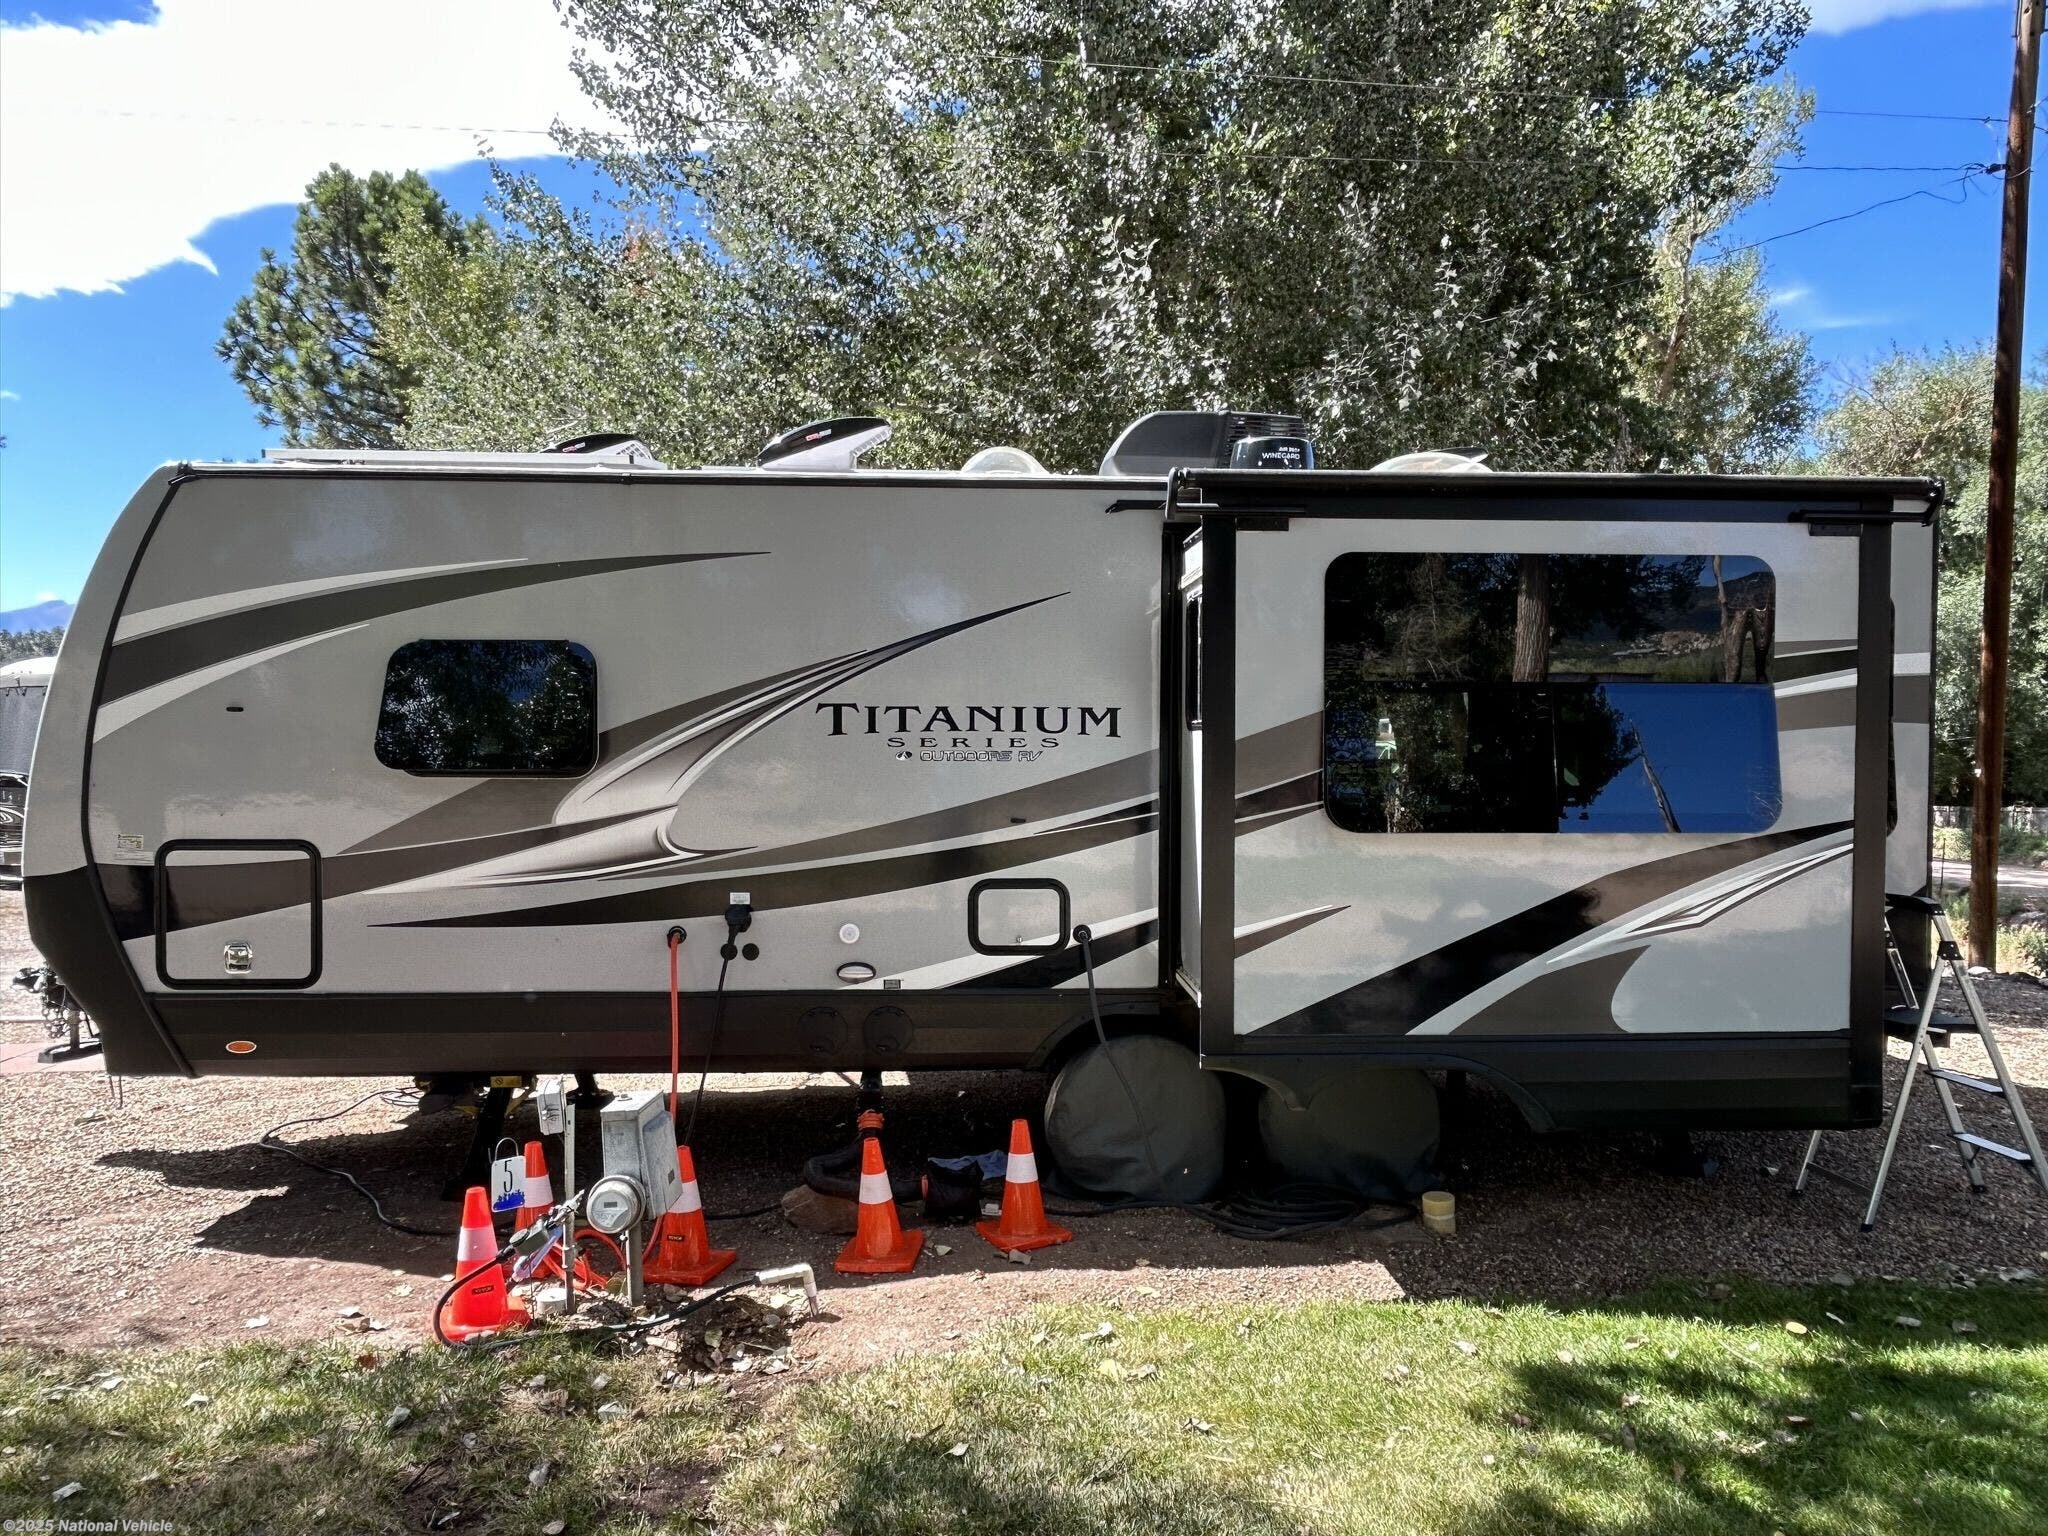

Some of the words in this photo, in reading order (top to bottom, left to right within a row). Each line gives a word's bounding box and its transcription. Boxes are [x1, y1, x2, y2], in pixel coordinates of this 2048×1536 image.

[1261, 452, 1300, 460] WINEGARD
[815, 702, 1122, 738] TITANIUM
[887, 737, 1059, 748] SERIES
[919, 750, 1014, 762] OUTDOORS
[1017, 750, 1043, 762] RV
[503, 1159, 513, 1193] 5
